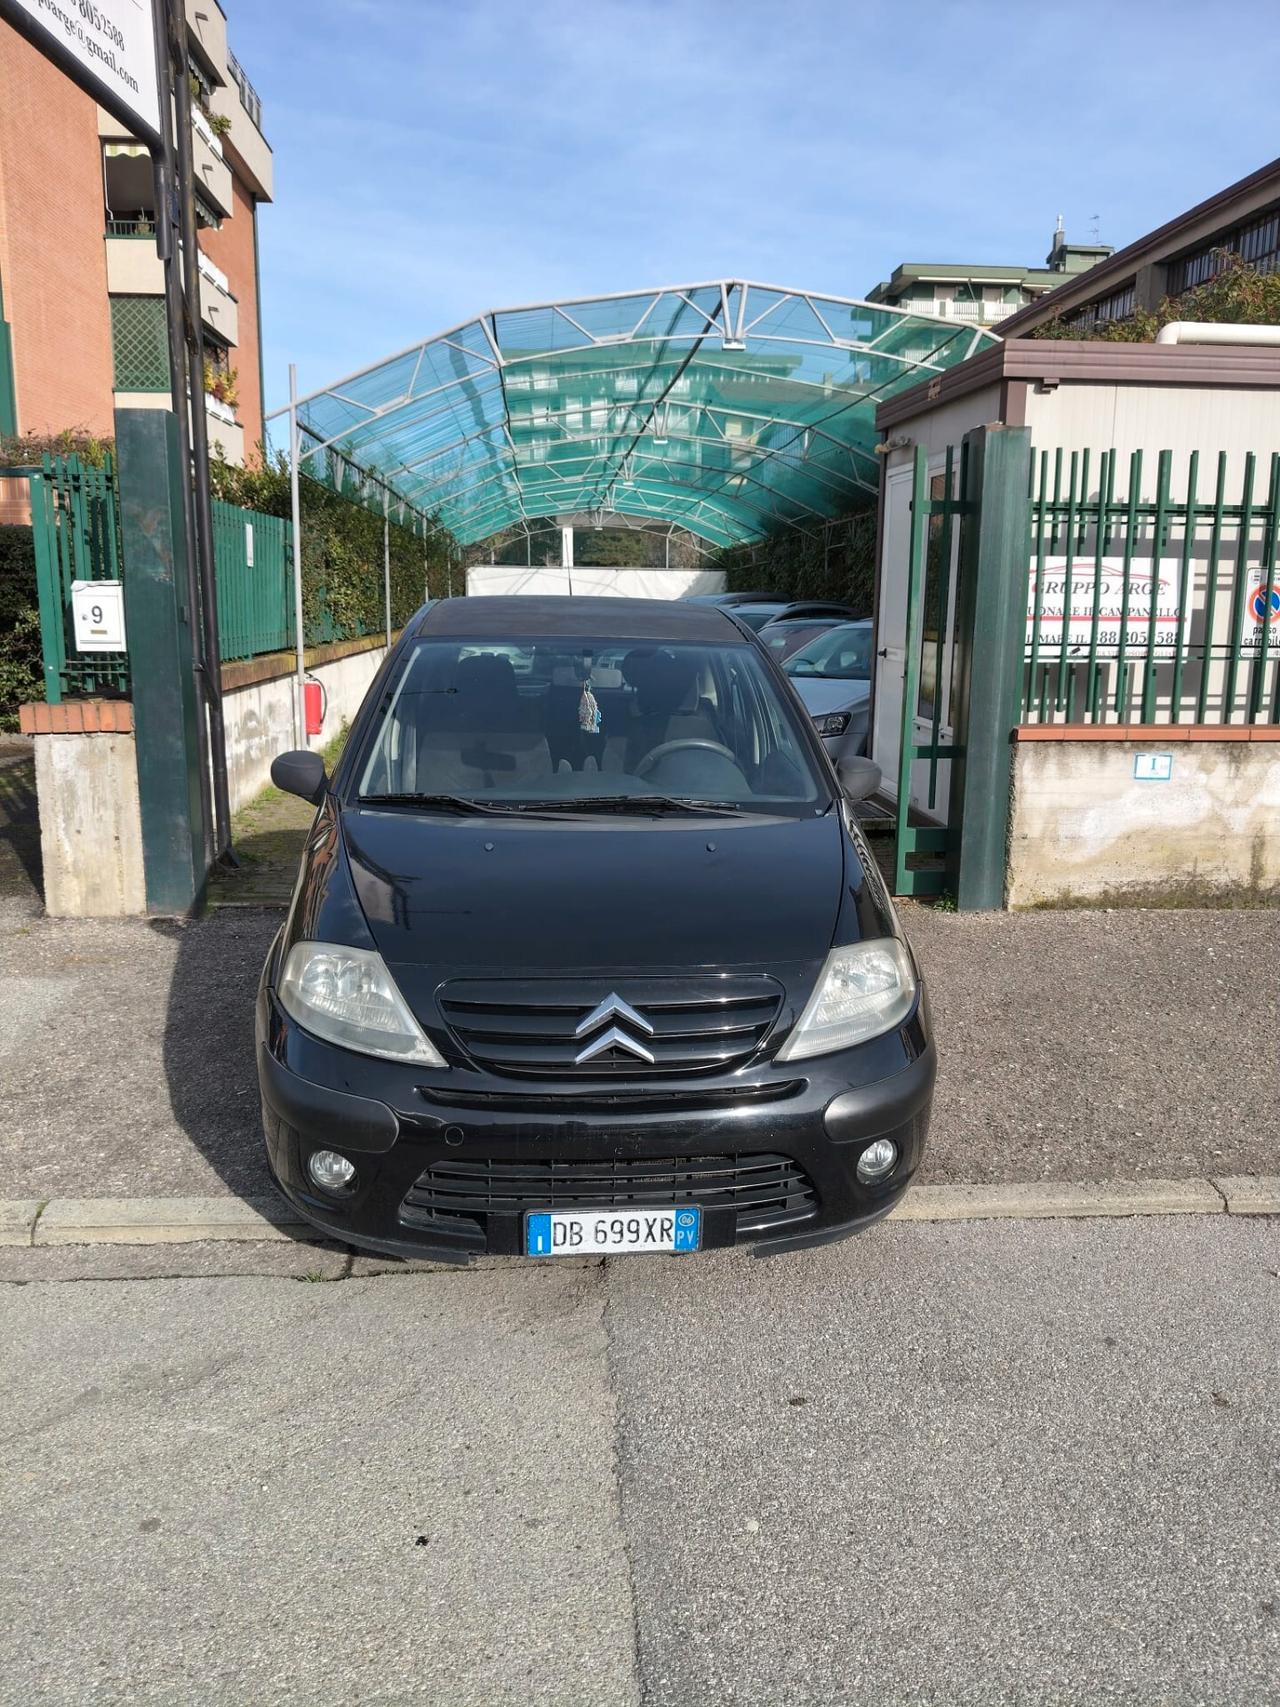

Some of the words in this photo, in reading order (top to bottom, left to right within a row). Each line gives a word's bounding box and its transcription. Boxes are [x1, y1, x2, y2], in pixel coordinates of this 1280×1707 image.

[38, 0, 139, 93] poarge@gmail.com
[1034, 581, 1110, 595] RUPPO
[91, 605, 103, 624] 9
[1098, 630, 1117, 644] 88
[1253, 627, 1276, 635] paso
[553, 1222, 583, 1247] DB
[595, 1217, 674, 1244] 699XR
[676, 1230, 694, 1245] PV
